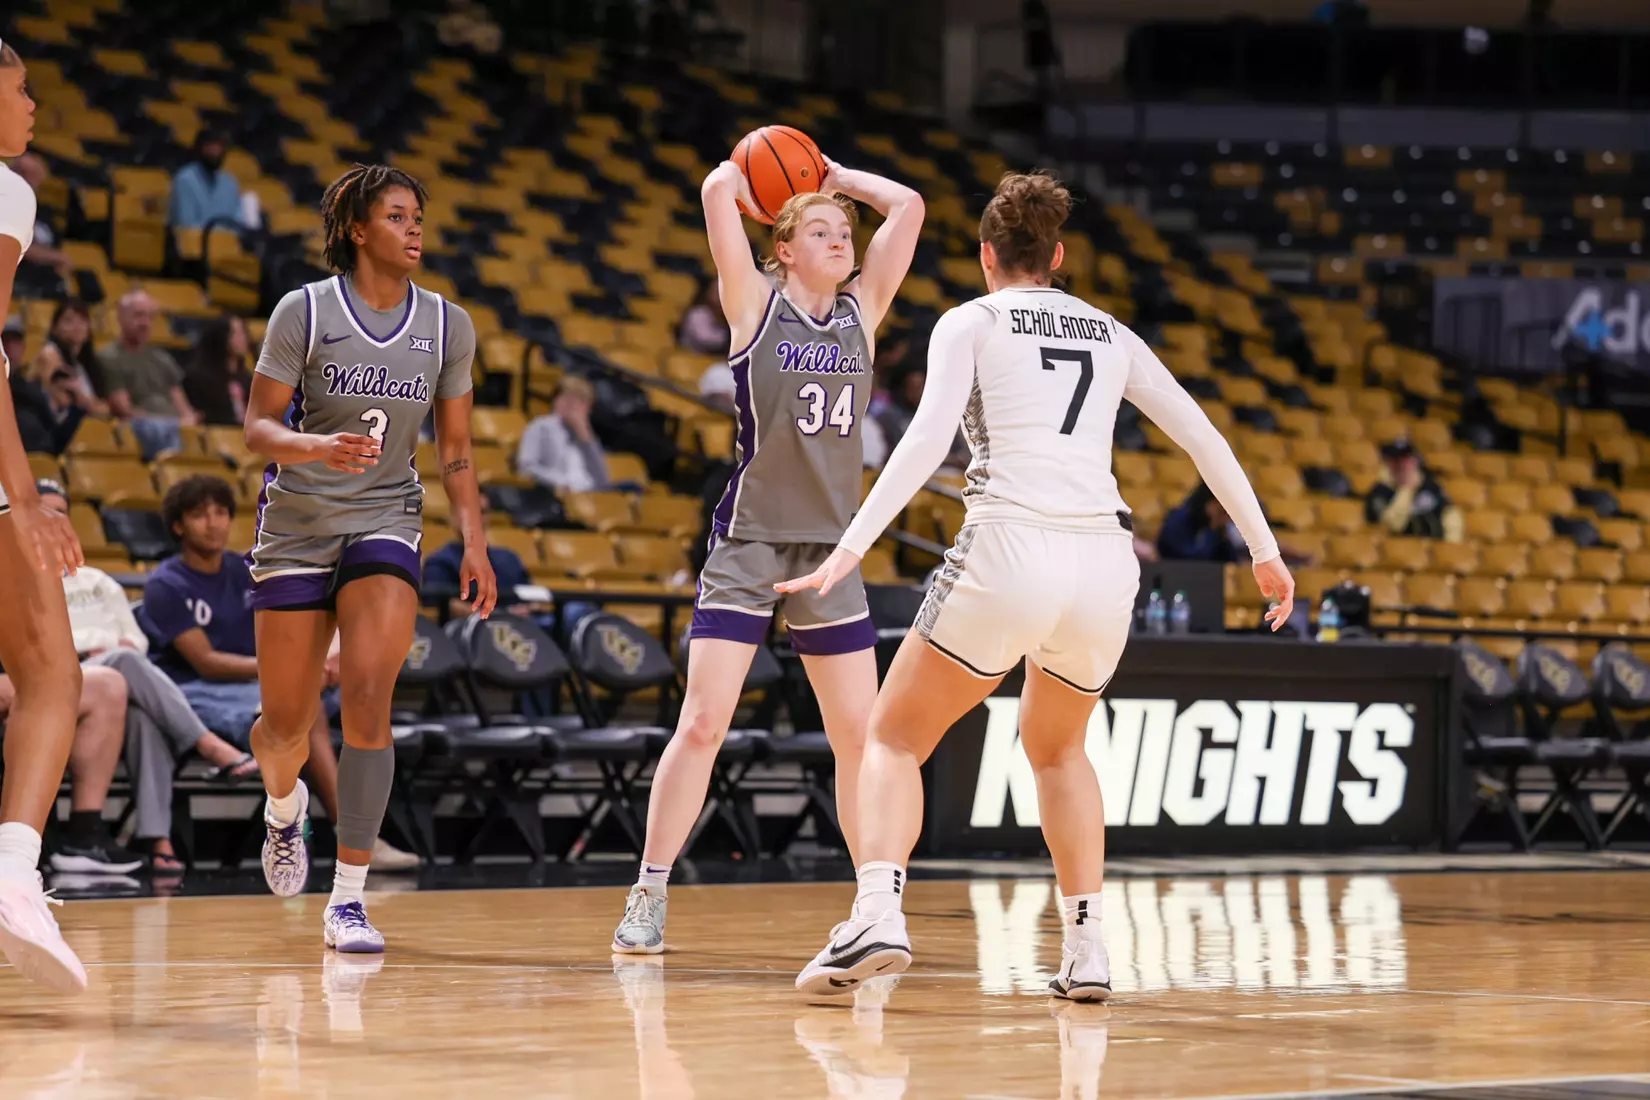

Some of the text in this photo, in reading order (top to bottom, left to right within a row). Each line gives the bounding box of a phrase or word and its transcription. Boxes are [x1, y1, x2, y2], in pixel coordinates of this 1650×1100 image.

[409, 335, 433, 354] XII
[1010, 308, 1112, 344] SCHÖLANDER
[776, 340, 865, 375] Wildcat
[322, 362, 429, 403] Wildcats
[1039, 346, 1094, 436] 7
[359, 406, 390, 458] 3
[796, 381, 855, 437] 34
[969, 697, 1415, 828] KNIGHTS
